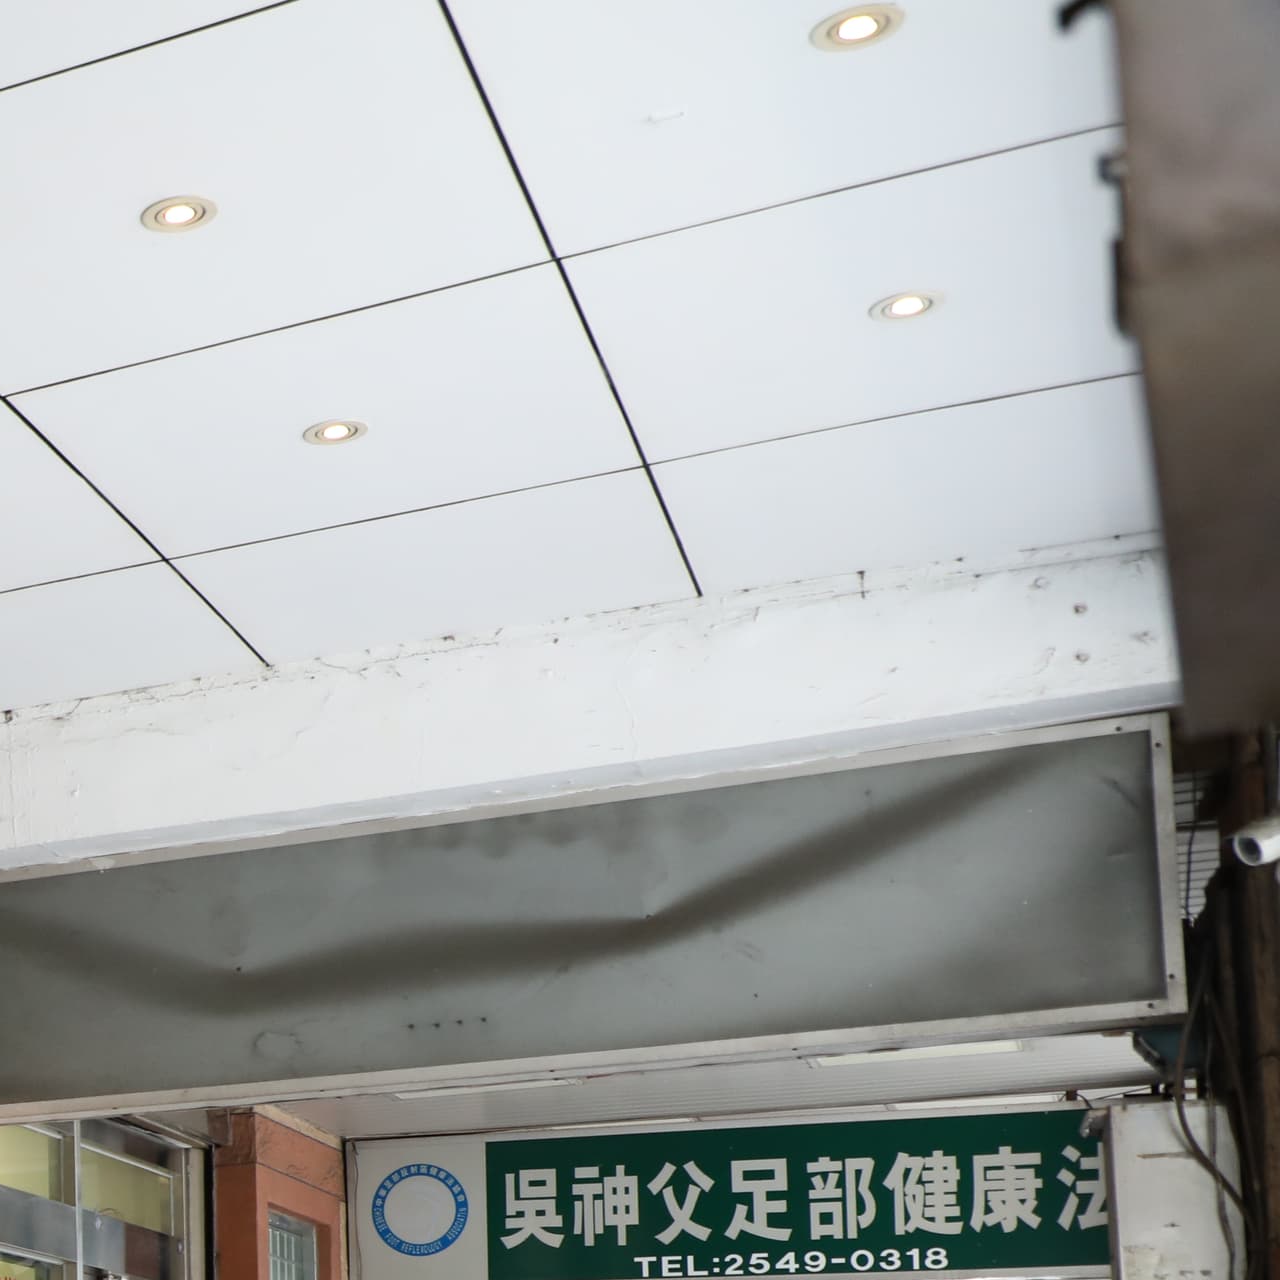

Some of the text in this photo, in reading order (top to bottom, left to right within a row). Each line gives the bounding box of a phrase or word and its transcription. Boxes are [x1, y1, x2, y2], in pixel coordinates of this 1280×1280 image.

[499, 1144, 1108, 1250] 吳神父足部健康法
[634, 1245, 950, 1279] TEL:2549-0318
